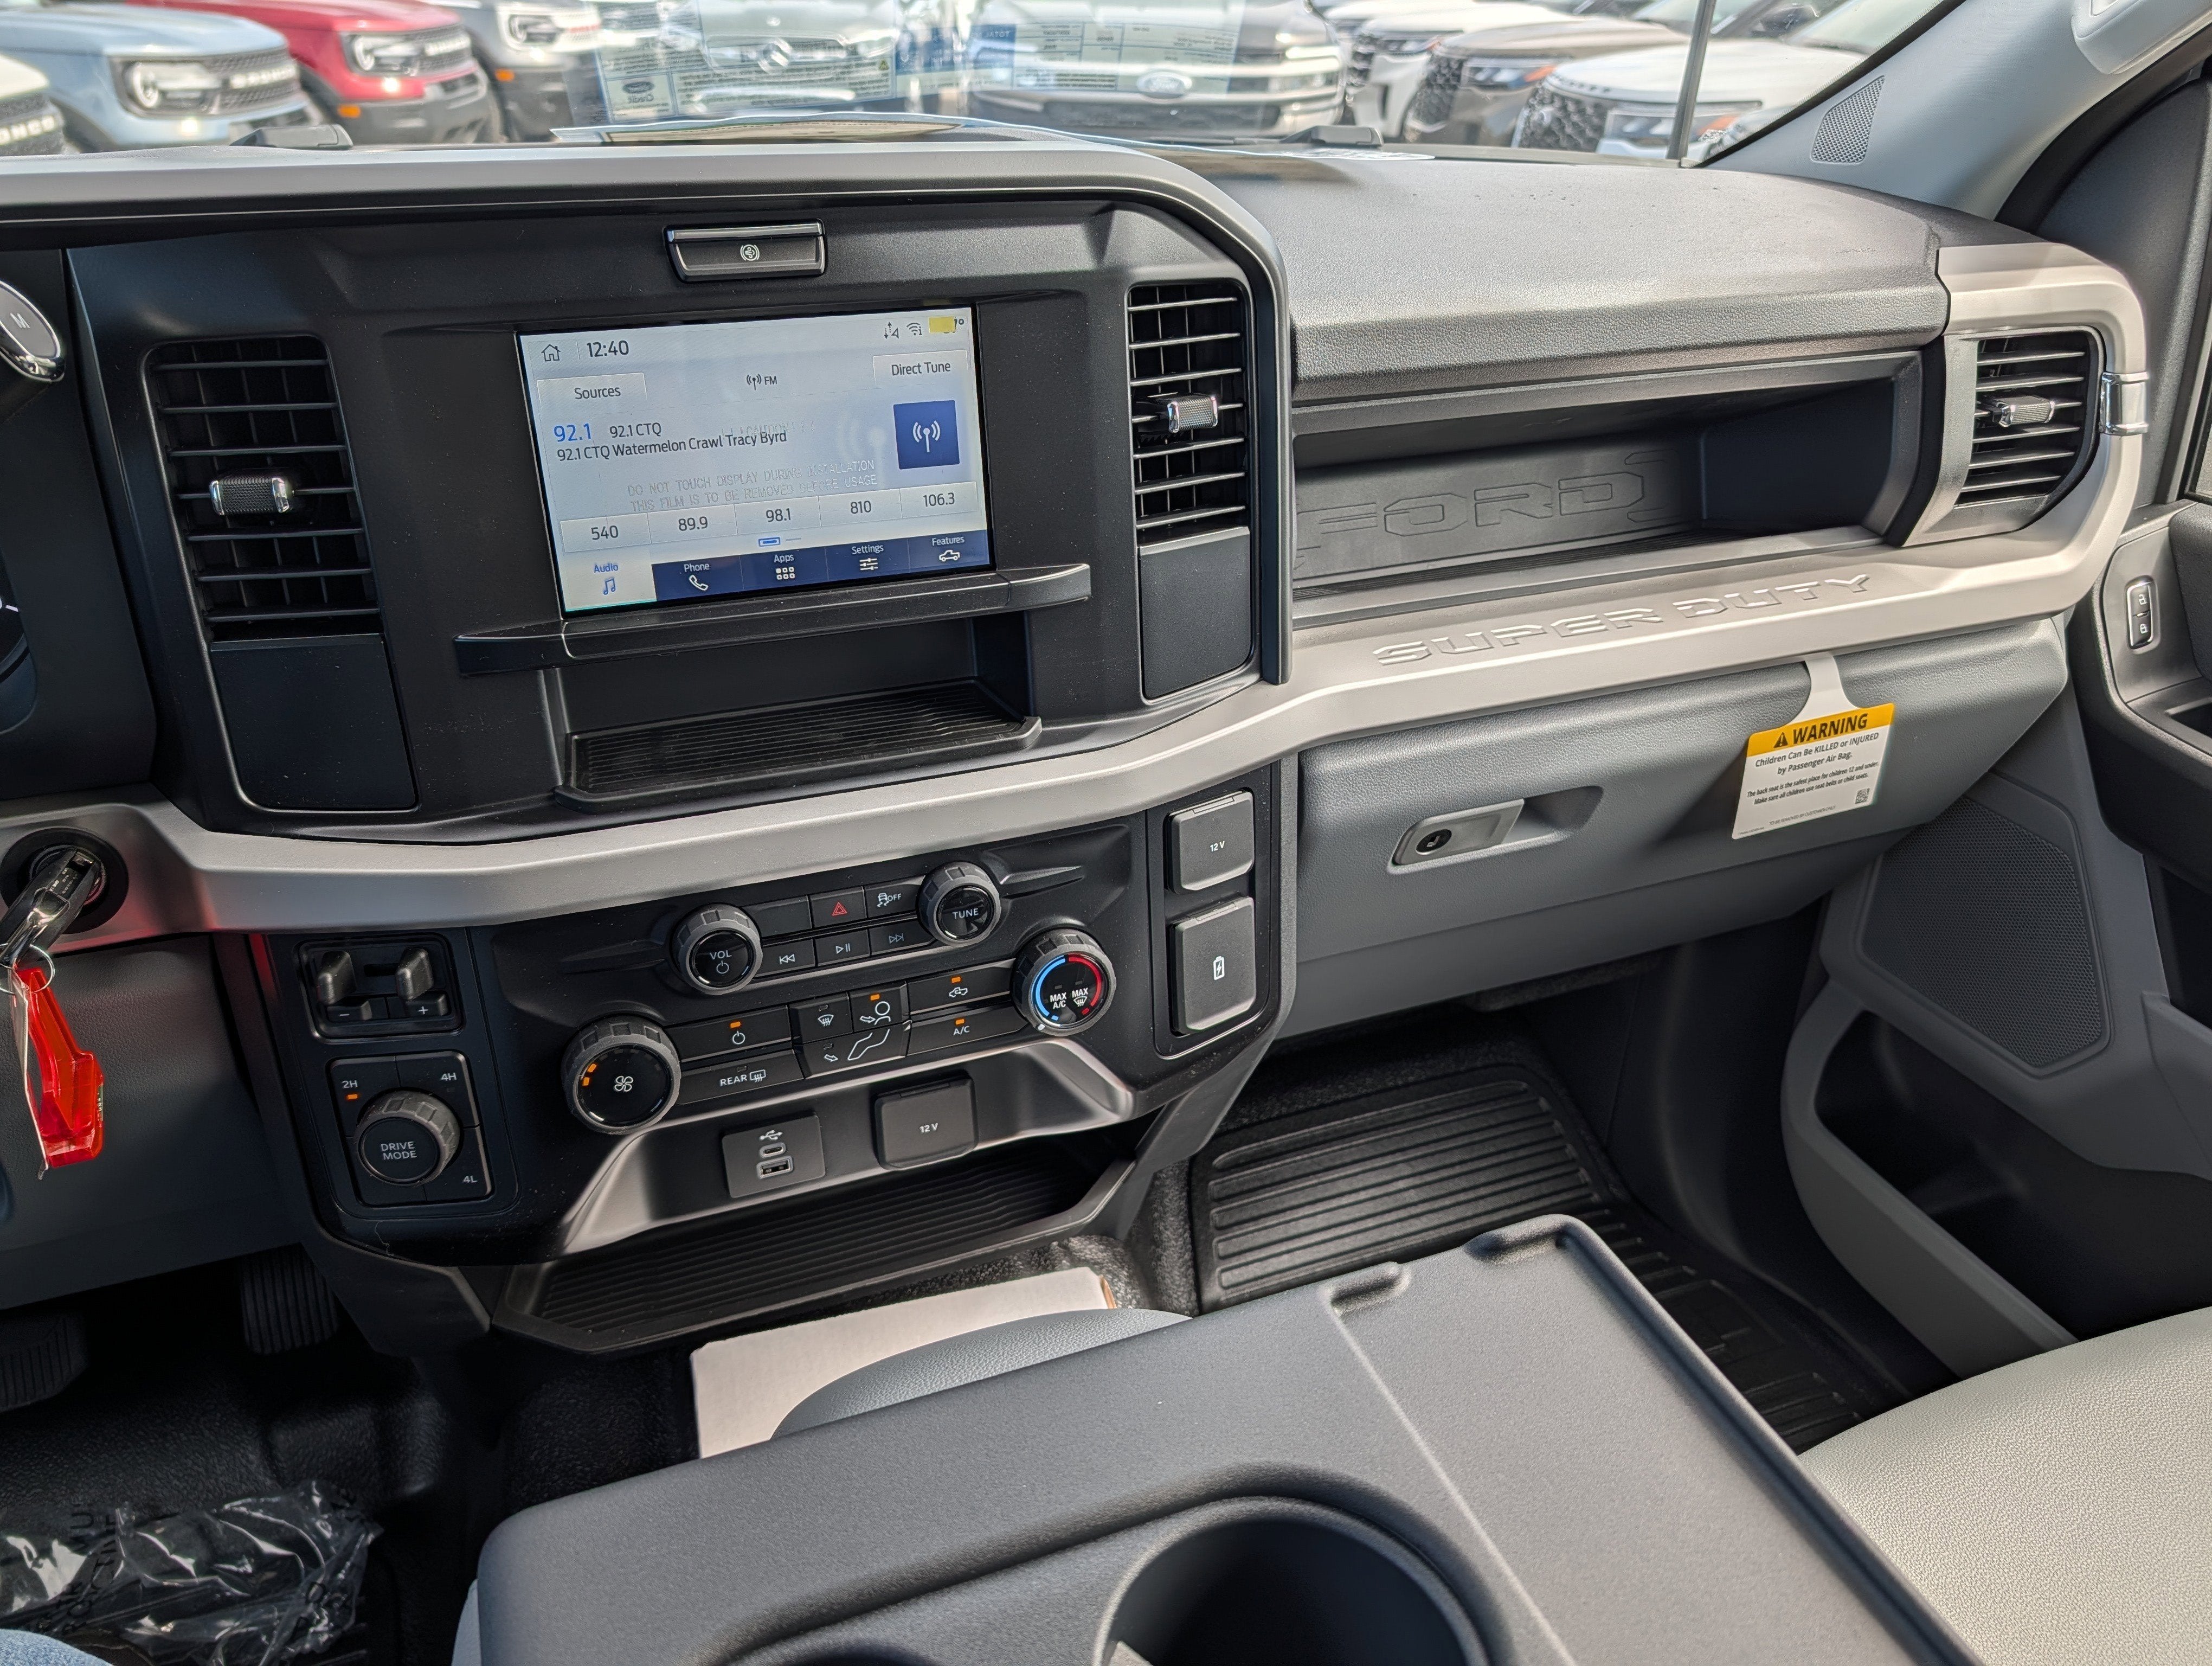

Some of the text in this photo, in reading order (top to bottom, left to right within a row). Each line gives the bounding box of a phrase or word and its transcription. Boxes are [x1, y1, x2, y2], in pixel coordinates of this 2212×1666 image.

[587, 340, 629, 357] 12:40
[891, 362, 951, 376] Direct Tune
[764, 375, 777, 385] FM
[574, 387, 621, 400] Sources
[554, 424, 591, 442] 92.1
[612, 440, 686, 457] Watermelon
[689, 435, 723, 450] Crawl
[725, 433, 757, 447] Tracy
[760, 431, 787, 445] Byrd
[628, 460, 874, 496] DO NOT TOUCH DISPLAY DURING INSTALLATION
[631, 499, 655, 511] THIS
[689, 494, 699, 505] IS
[704, 492, 719, 503] TO
[724, 489, 740, 502] BE
[744, 483, 794, 499] REMOVED
[800, 478, 839, 494] BEFORE
[844, 475, 877, 488] USAGE
[923, 492, 955, 507] 106.3
[850, 500, 872, 514] 810
[1297, 472, 1644, 548] FORD
[766, 508, 791, 522] 98.1
[678, 516, 708, 531] 89.9
[591, 525, 619, 540] 540
[931, 535, 965, 547] Features
[852, 543, 884, 555] Settings
[774, 553, 795, 564] Apps
[594, 563, 619, 573] Audio
[684, 562, 710, 572] Phone
[1373, 574, 1870, 666] SUPER DUTY
[1792, 713, 1868, 745] WARNING
[1756, 754, 1787, 767] Children
[1788, 751, 1802, 760] Can
[1814, 741, 1839, 754] KILLED
[1849, 732, 1879, 746] INJURED
[1777, 752, 1852, 776] by Passenger Air Bag.
[1757, 787, 1768, 795] back
[1793, 778, 1808, 786] safest
[1808, 776, 1821, 784] place
[1829, 769, 1848, 778] children
[1753, 797, 1767, 805] Make
[1786, 788, 1805, 797] children
[1844, 775, 1855, 783] child
[1210, 840, 1225, 852] 12 V
[888, 892, 902, 902] OFF
[952, 907, 979, 920] TUNE
[710, 950, 732, 960] VOL
[1050, 992, 1066, 1002] MAX
[1071, 988, 1088, 997] MAX
[1053, 1001, 1066, 1009] A/C
[953, 1026, 970, 1036] A/C
[342, 1079, 358, 1088] 2H
[441, 1072, 457, 1082] 4H
[720, 1074, 748, 1087] REAR
[919, 1123, 938, 1133] 12 V
[381, 1140, 415, 1151] DRIVE
[383, 1150, 417, 1161] MODE
[463, 1175, 478, 1183] 4L
